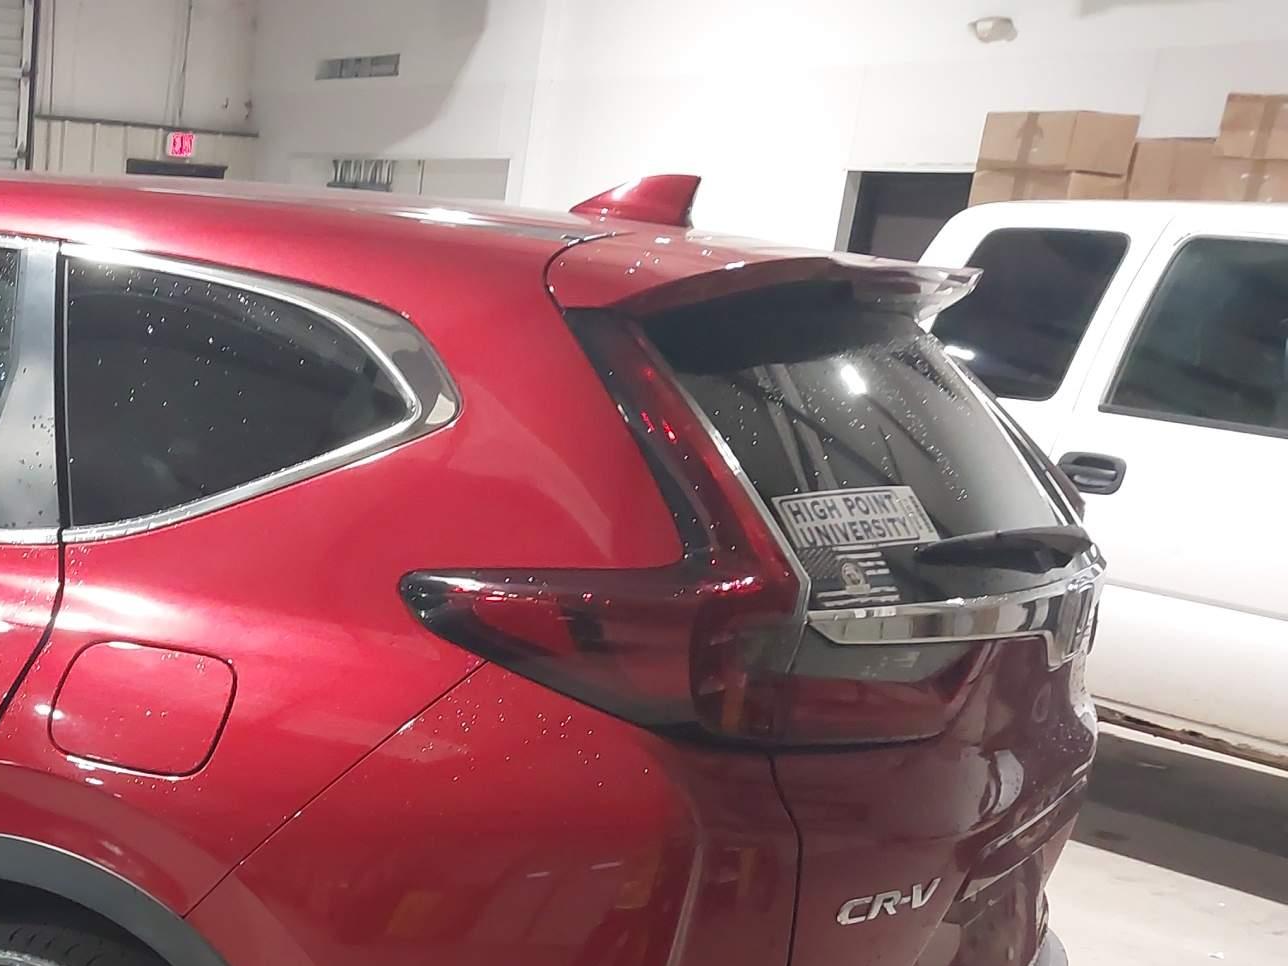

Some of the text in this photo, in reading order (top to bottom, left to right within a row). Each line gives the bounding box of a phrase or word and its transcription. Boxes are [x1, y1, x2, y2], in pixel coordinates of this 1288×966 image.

[787, 497, 843, 525] HIGH
[841, 493, 899, 518] POINT
[798, 515, 912, 547] UNIVERSITY
[836, 876, 943, 926] CR-V
